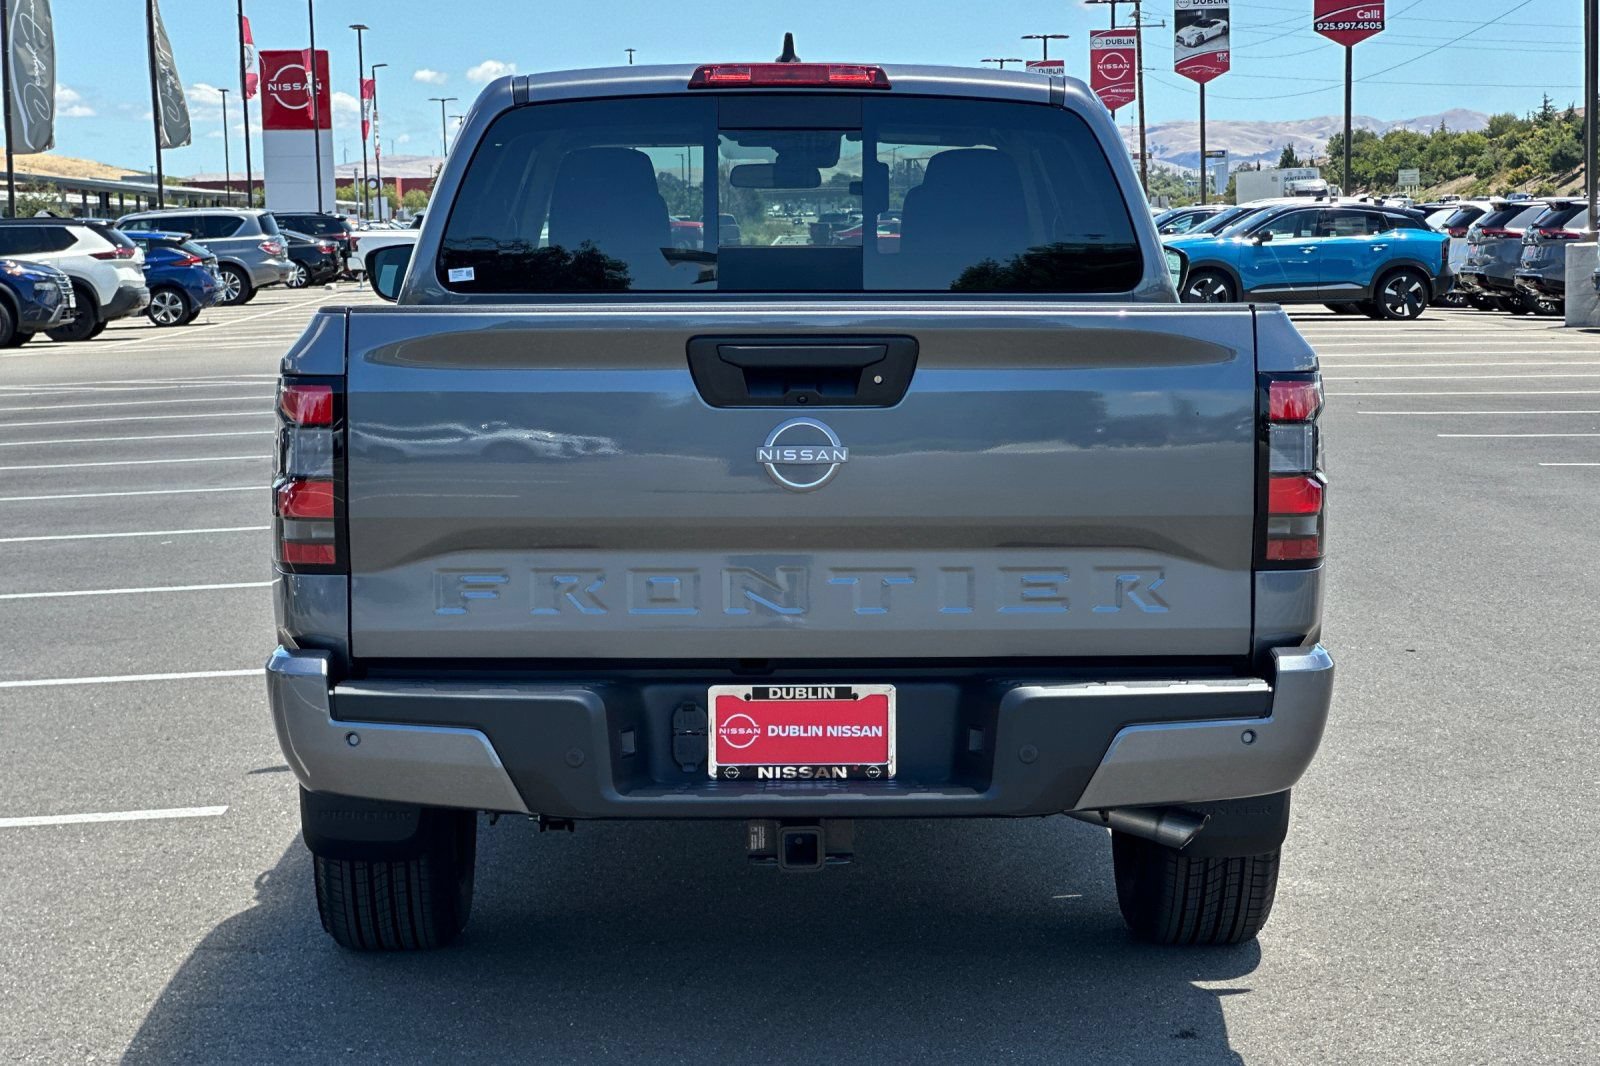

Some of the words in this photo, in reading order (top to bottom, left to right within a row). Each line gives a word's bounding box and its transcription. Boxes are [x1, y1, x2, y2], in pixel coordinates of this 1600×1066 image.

[1356, 10, 1380, 19] Call!
[1317, 22, 1382, 30] 925.997.4505
[759, 449, 847, 461] NISSAN
[433, 566, 1171, 616] FRONTIER
[768, 687, 836, 699] DUBLIN
[719, 727, 761, 735] NISSAN
[767, 725, 823, 737] DUBLIN
[826, 725, 883, 737] NISSAN
[757, 766, 848, 779] NISSAN
